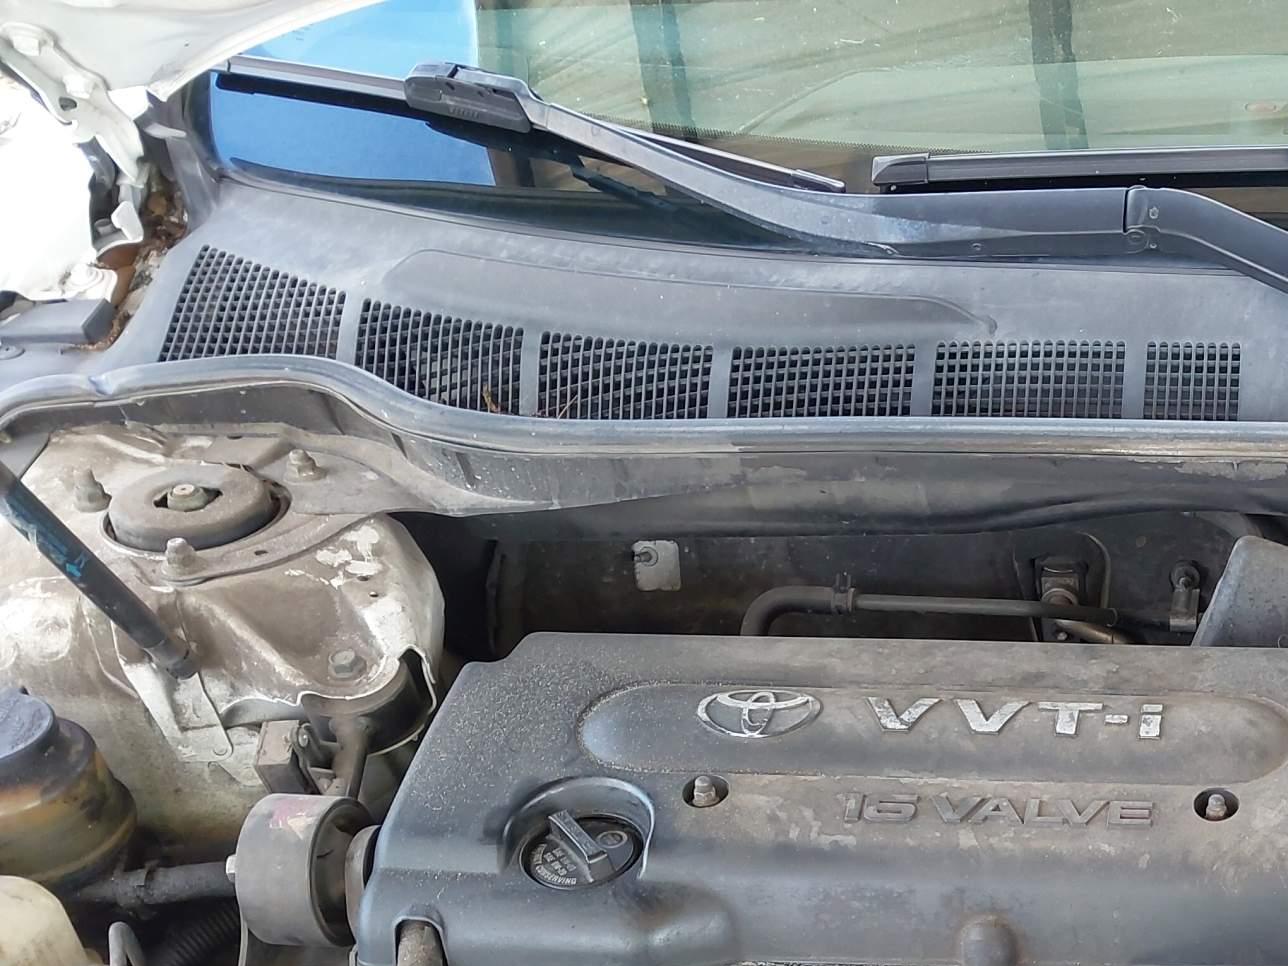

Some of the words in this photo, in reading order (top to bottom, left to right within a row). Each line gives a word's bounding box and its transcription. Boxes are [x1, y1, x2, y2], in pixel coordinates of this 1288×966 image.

[866, 696, 1163, 740] VVT-i
[840, 793, 918, 823] 16
[930, 796, 1153, 828] VALVE
